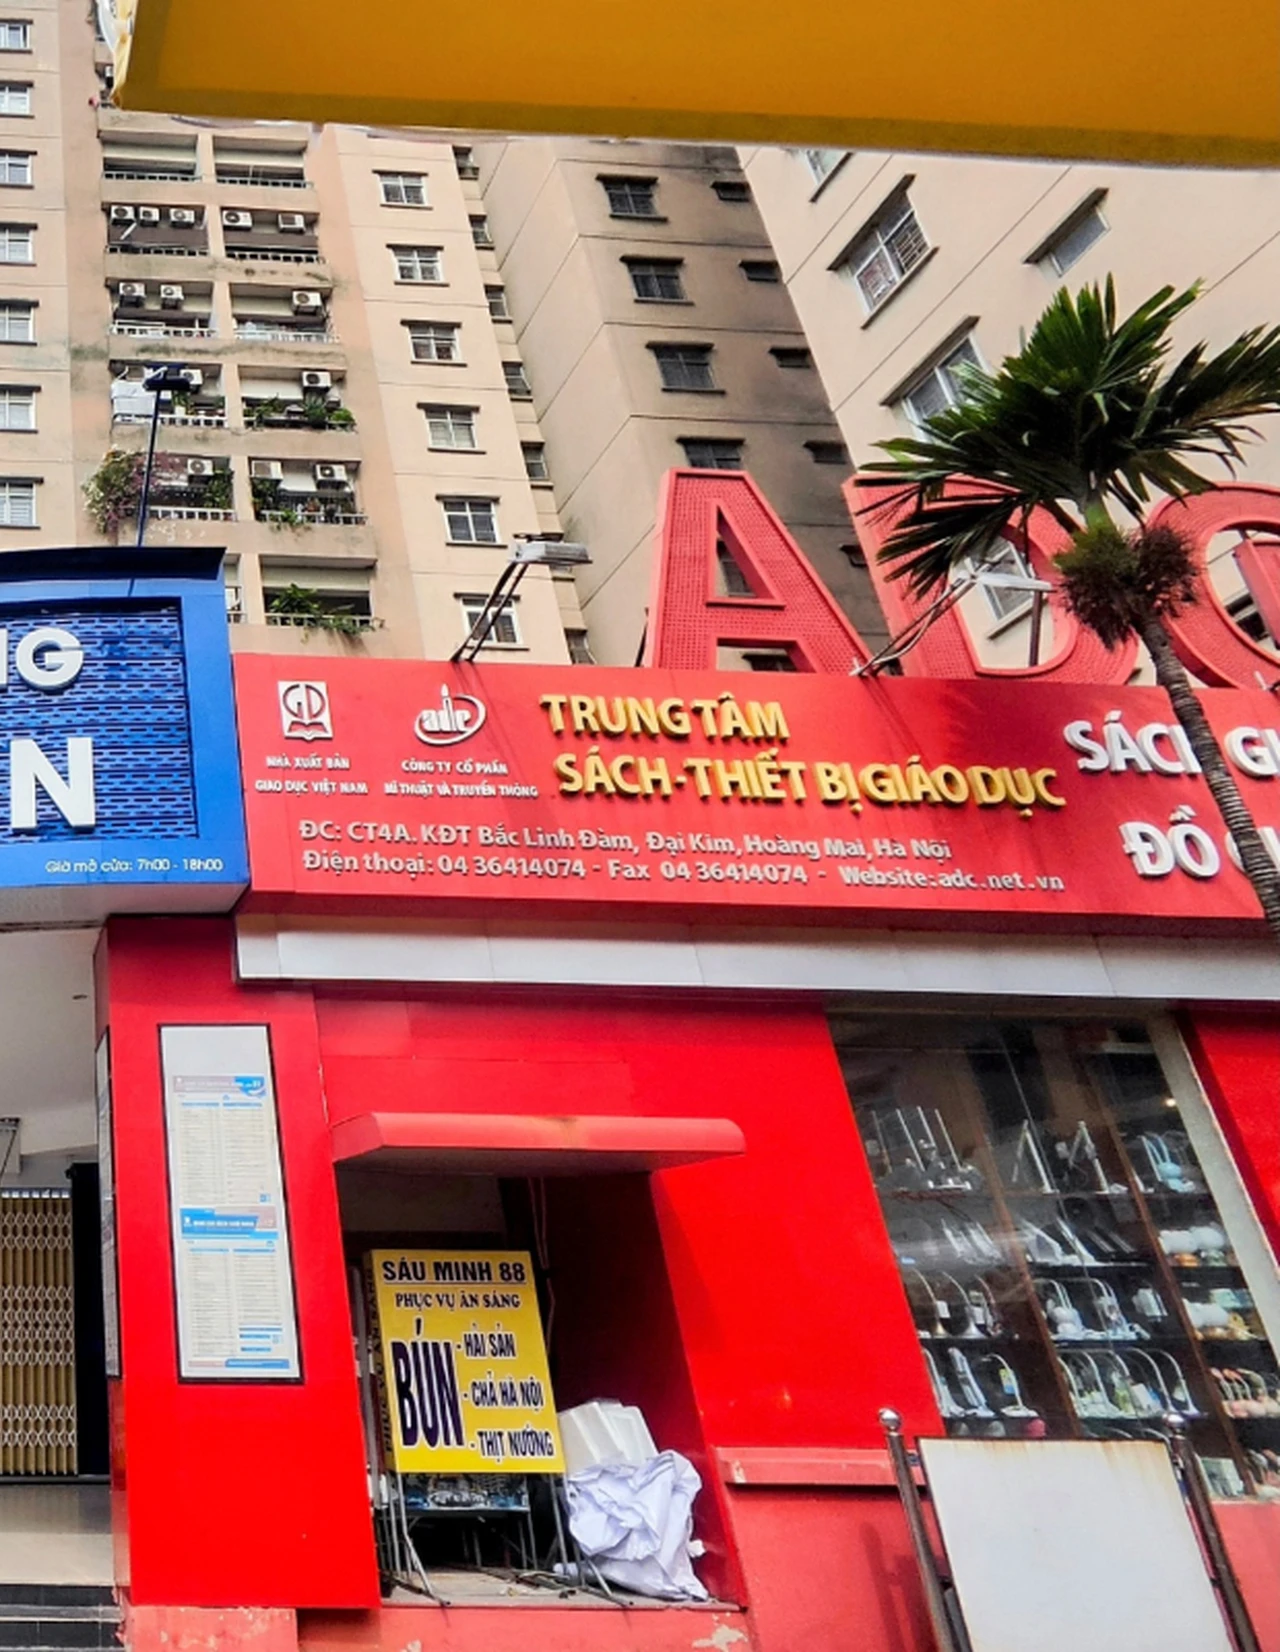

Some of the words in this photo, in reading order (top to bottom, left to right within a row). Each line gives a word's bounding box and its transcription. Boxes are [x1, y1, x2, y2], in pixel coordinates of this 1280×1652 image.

[538, 693, 691, 739] TRUNG
[691, 690, 791, 741] TÂM
[1063, 709, 1204, 775] SÁC
[401, 757, 434, 773] CÔNG
[436, 761, 452, 773] TY
[311, 778, 337, 797] VIỆT
[340, 782, 368, 795] NAM
[437, 780, 451, 796] VÀ
[814, 760, 864, 813] BỊ
[859, 755, 972, 805] GIÁO
[974, 764, 1068, 819] DỤC
[299, 820, 341, 841] ĐC:
[422, 823, 471, 845] KĐT
[478, 823, 519, 846] Bắc
[523, 827, 575, 849] Linh
[578, 829, 639, 855] Đàm,
[646, 830, 684, 856] Đại
[743, 834, 820, 860] Hoàng
[874, 838, 907, 858] Hà
[911, 839, 952, 864] Nội
[182, 858, 224, 872] 18h00
[303, 850, 358, 875] Điện
[363, 851, 433, 878] thoại:
[437, 854, 468, 875] 04
[474, 856, 586, 878] 36414074
[607, 859, 650, 880] Fax
[660, 861, 692, 881] 04
[696, 862, 808, 884] 36414074
[382, 1257, 425, 1282] SÁU
[434, 1261, 492, 1282] MINH
[499, 1262, 526, 1283] 88
[395, 1293, 432, 1312] PHỤC
[436, 1294, 455, 1312] VỤ
[482, 1289, 521, 1308] SÁNG
[391, 1317, 465, 1448] BÚN
[471, 1371, 498, 1407] CHẢ
[520, 1376, 545, 1413] NỘI
[477, 1430, 505, 1463] THỊT
[508, 1423, 555, 1458] NƯỚNG
